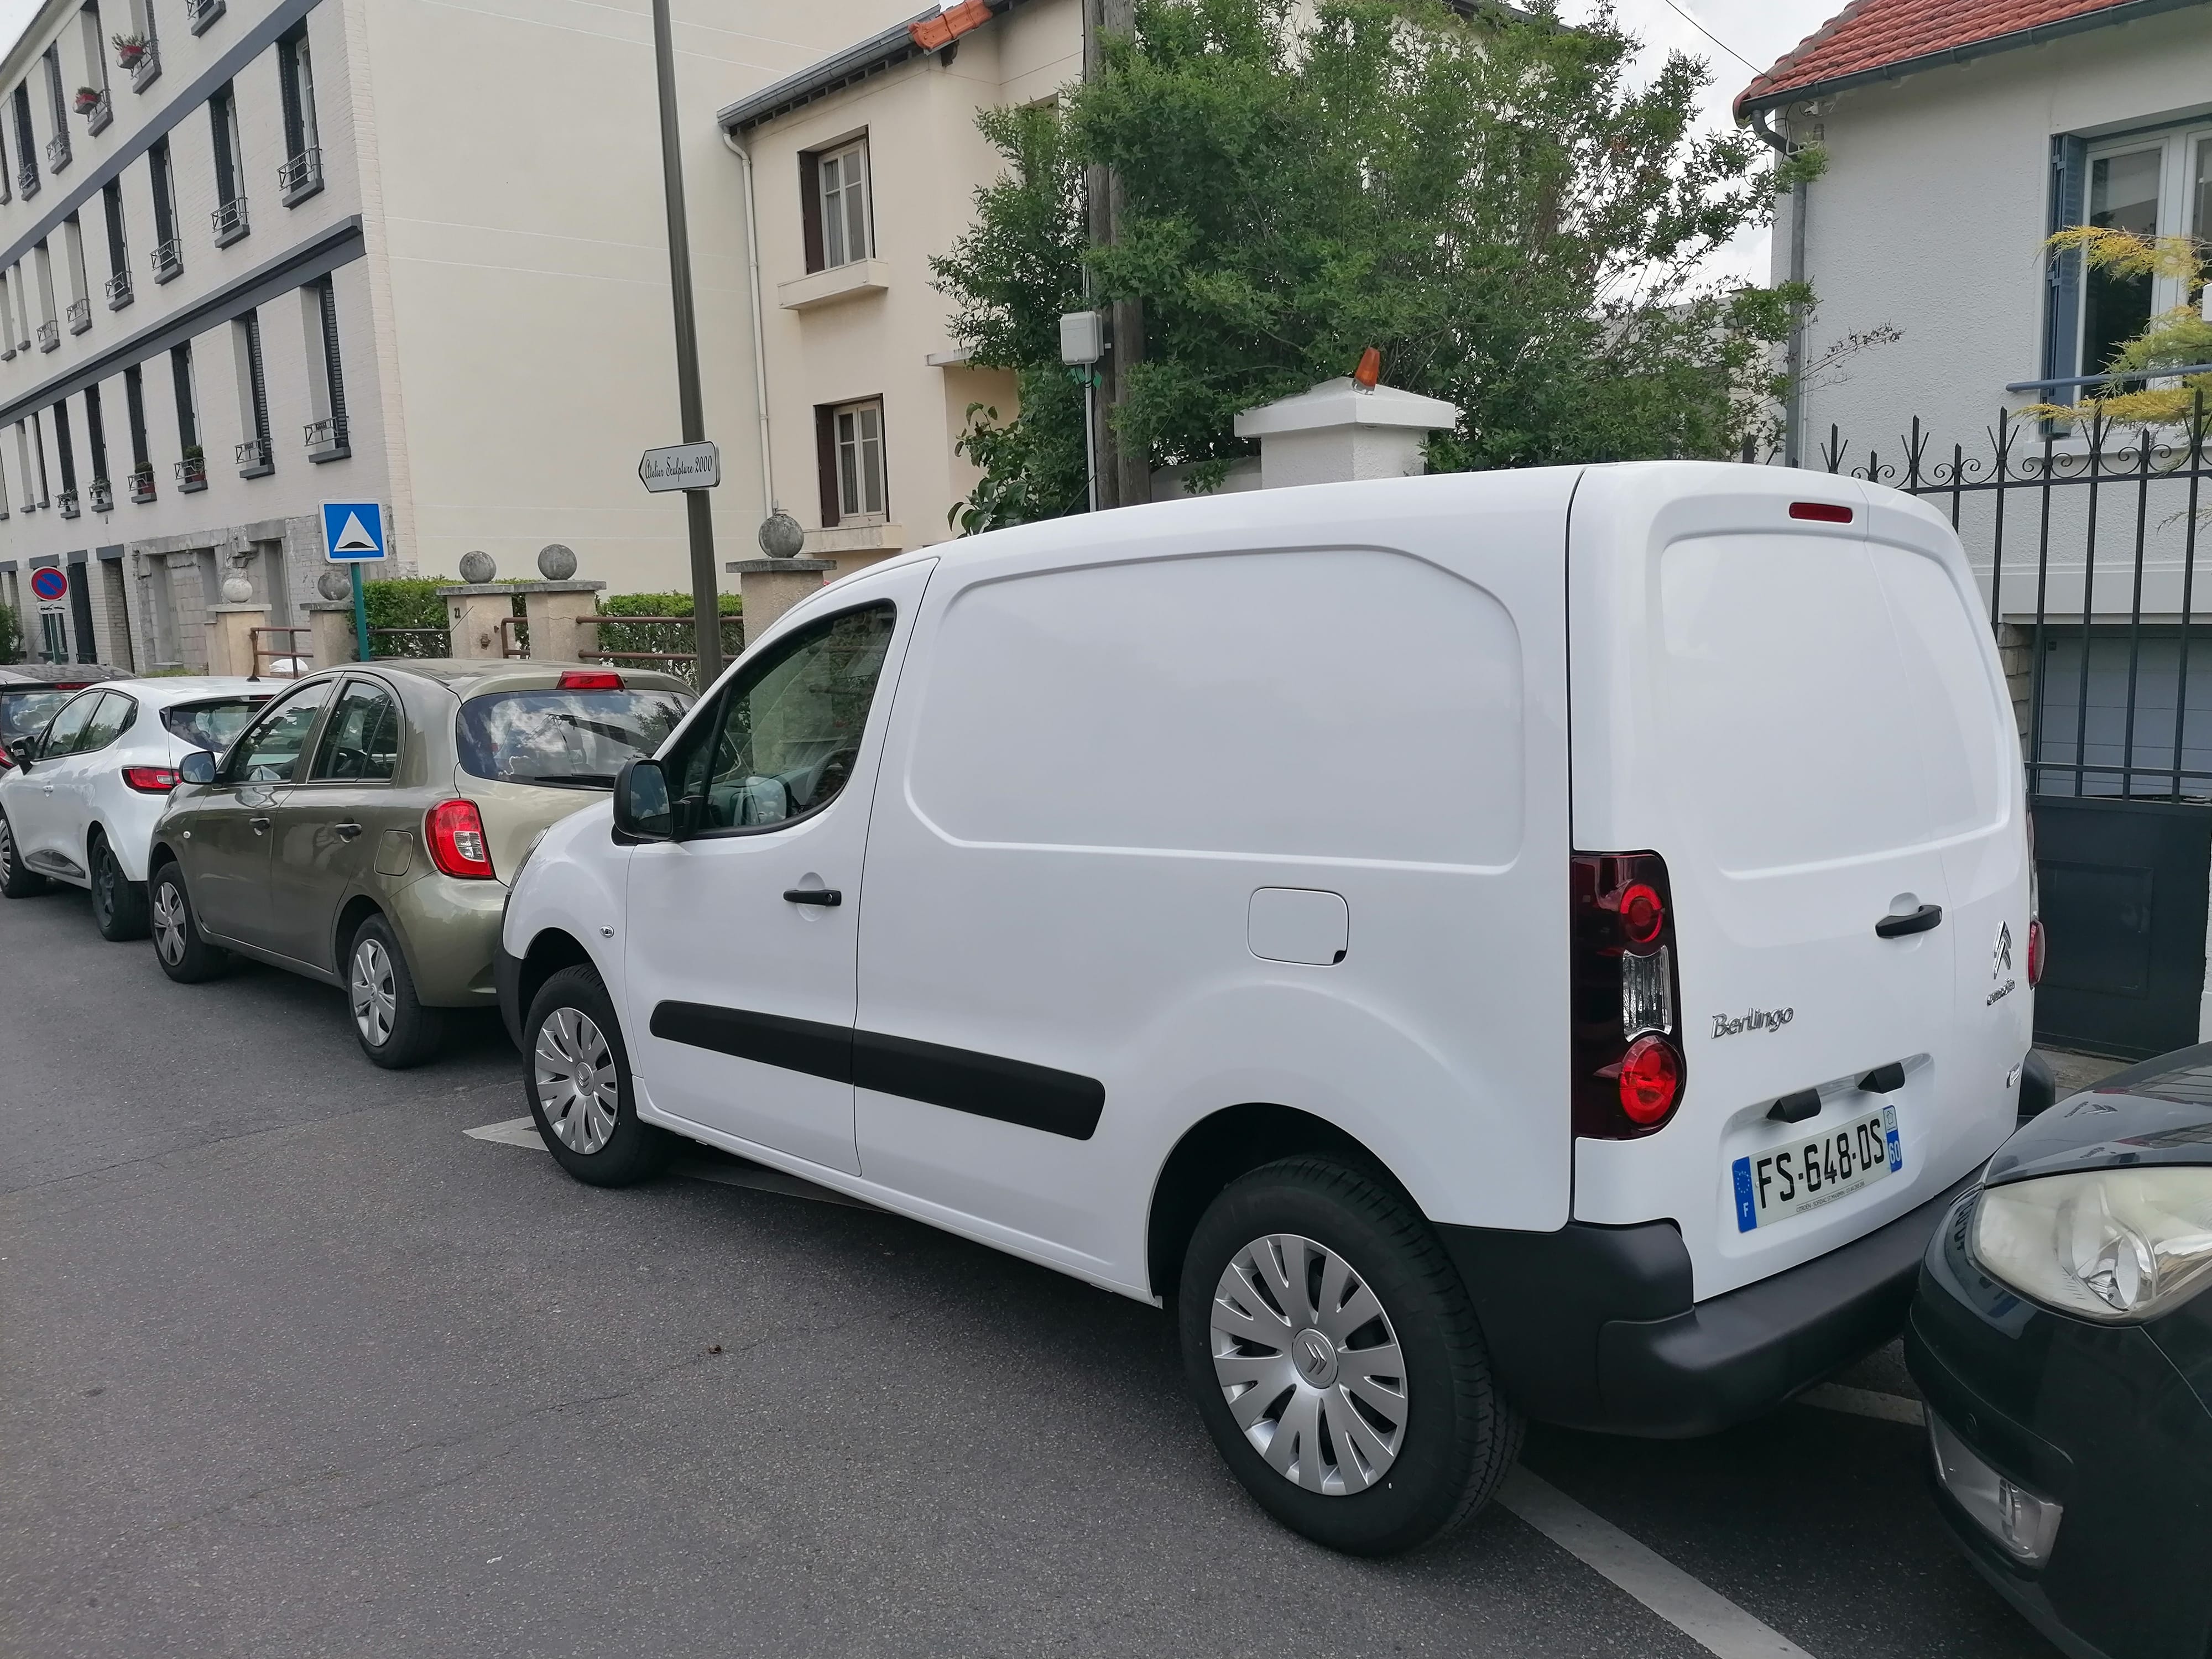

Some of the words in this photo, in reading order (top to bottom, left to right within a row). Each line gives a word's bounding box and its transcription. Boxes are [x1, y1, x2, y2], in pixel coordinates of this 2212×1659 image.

[645, 459, 664, 479] Atelier
[666, 456, 694, 482] Sculpture
[695, 455, 712, 473] 2000
[1711, 1007, 1794, 1039] Berlingo
[1756, 1118, 1885, 1209] FS-648-DS
[1888, 1140, 1901, 1164] 60
[1743, 1202, 1749, 1217] F
